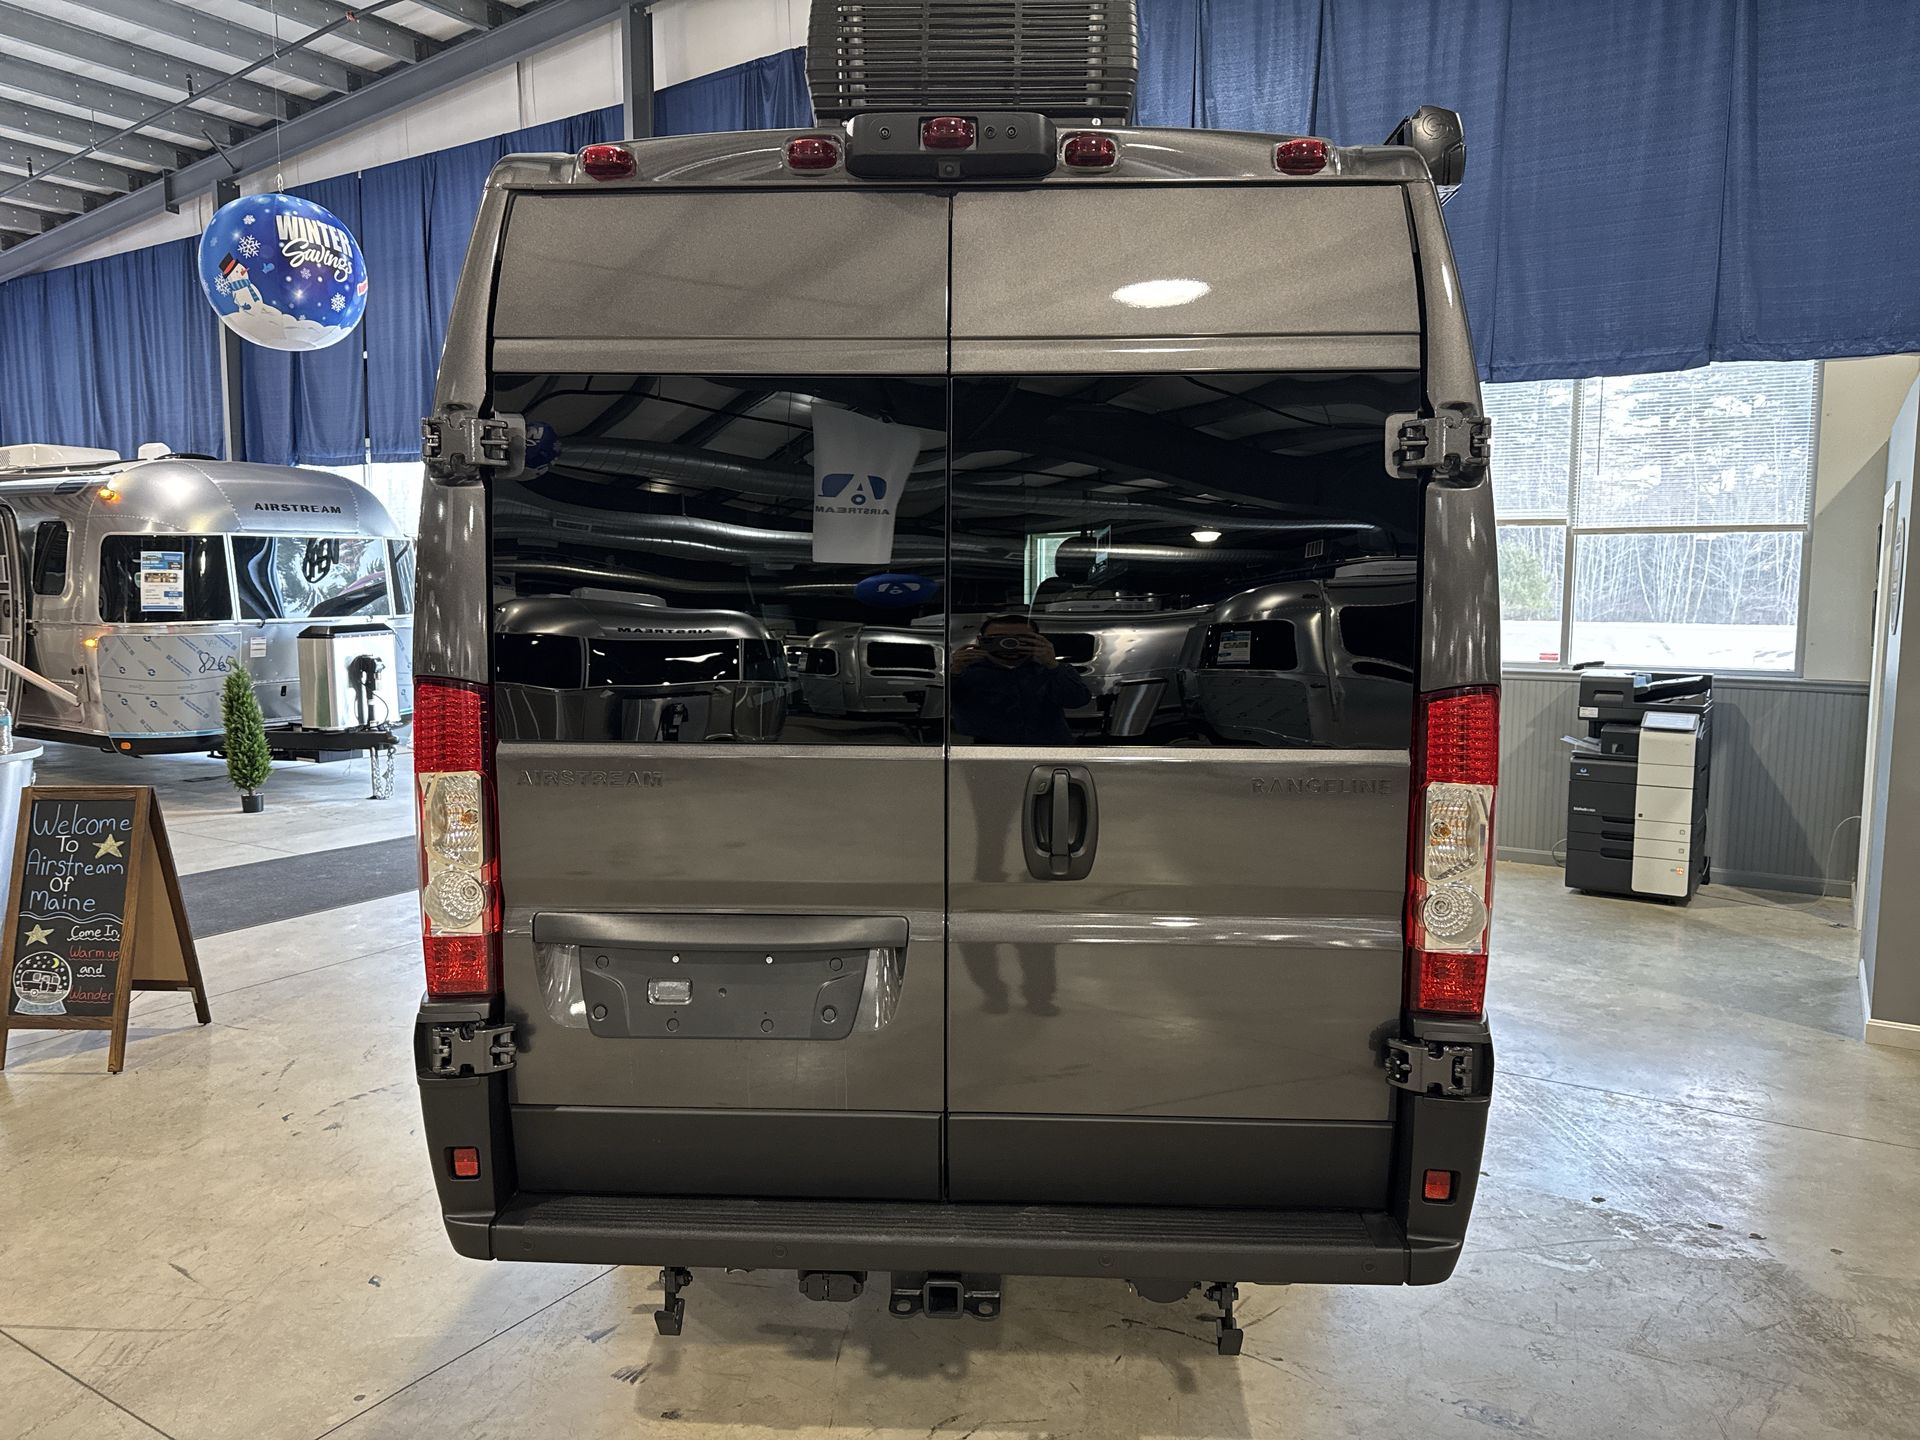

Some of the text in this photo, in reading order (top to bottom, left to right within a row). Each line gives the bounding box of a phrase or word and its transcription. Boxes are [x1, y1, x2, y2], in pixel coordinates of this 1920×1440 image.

[275, 214, 353, 258] WINTER
[281, 237, 353, 283] Savings
[254, 502, 342, 514] AIRSTREAM
[517, 769, 664, 788] AIRSTREAM
[1251, 777, 1393, 795] RANGELINE
[33, 803, 132, 835] Welcome
[55, 835, 79, 853] To
[25, 848, 124, 877] Airstream
[49, 876, 74, 893] Of
[29, 890, 96, 912] Maine
[70, 925, 102, 938] Come
[69, 945, 120, 960] Warm up
[79, 963, 103, 974] and
[69, 985, 114, 1000] Wander
